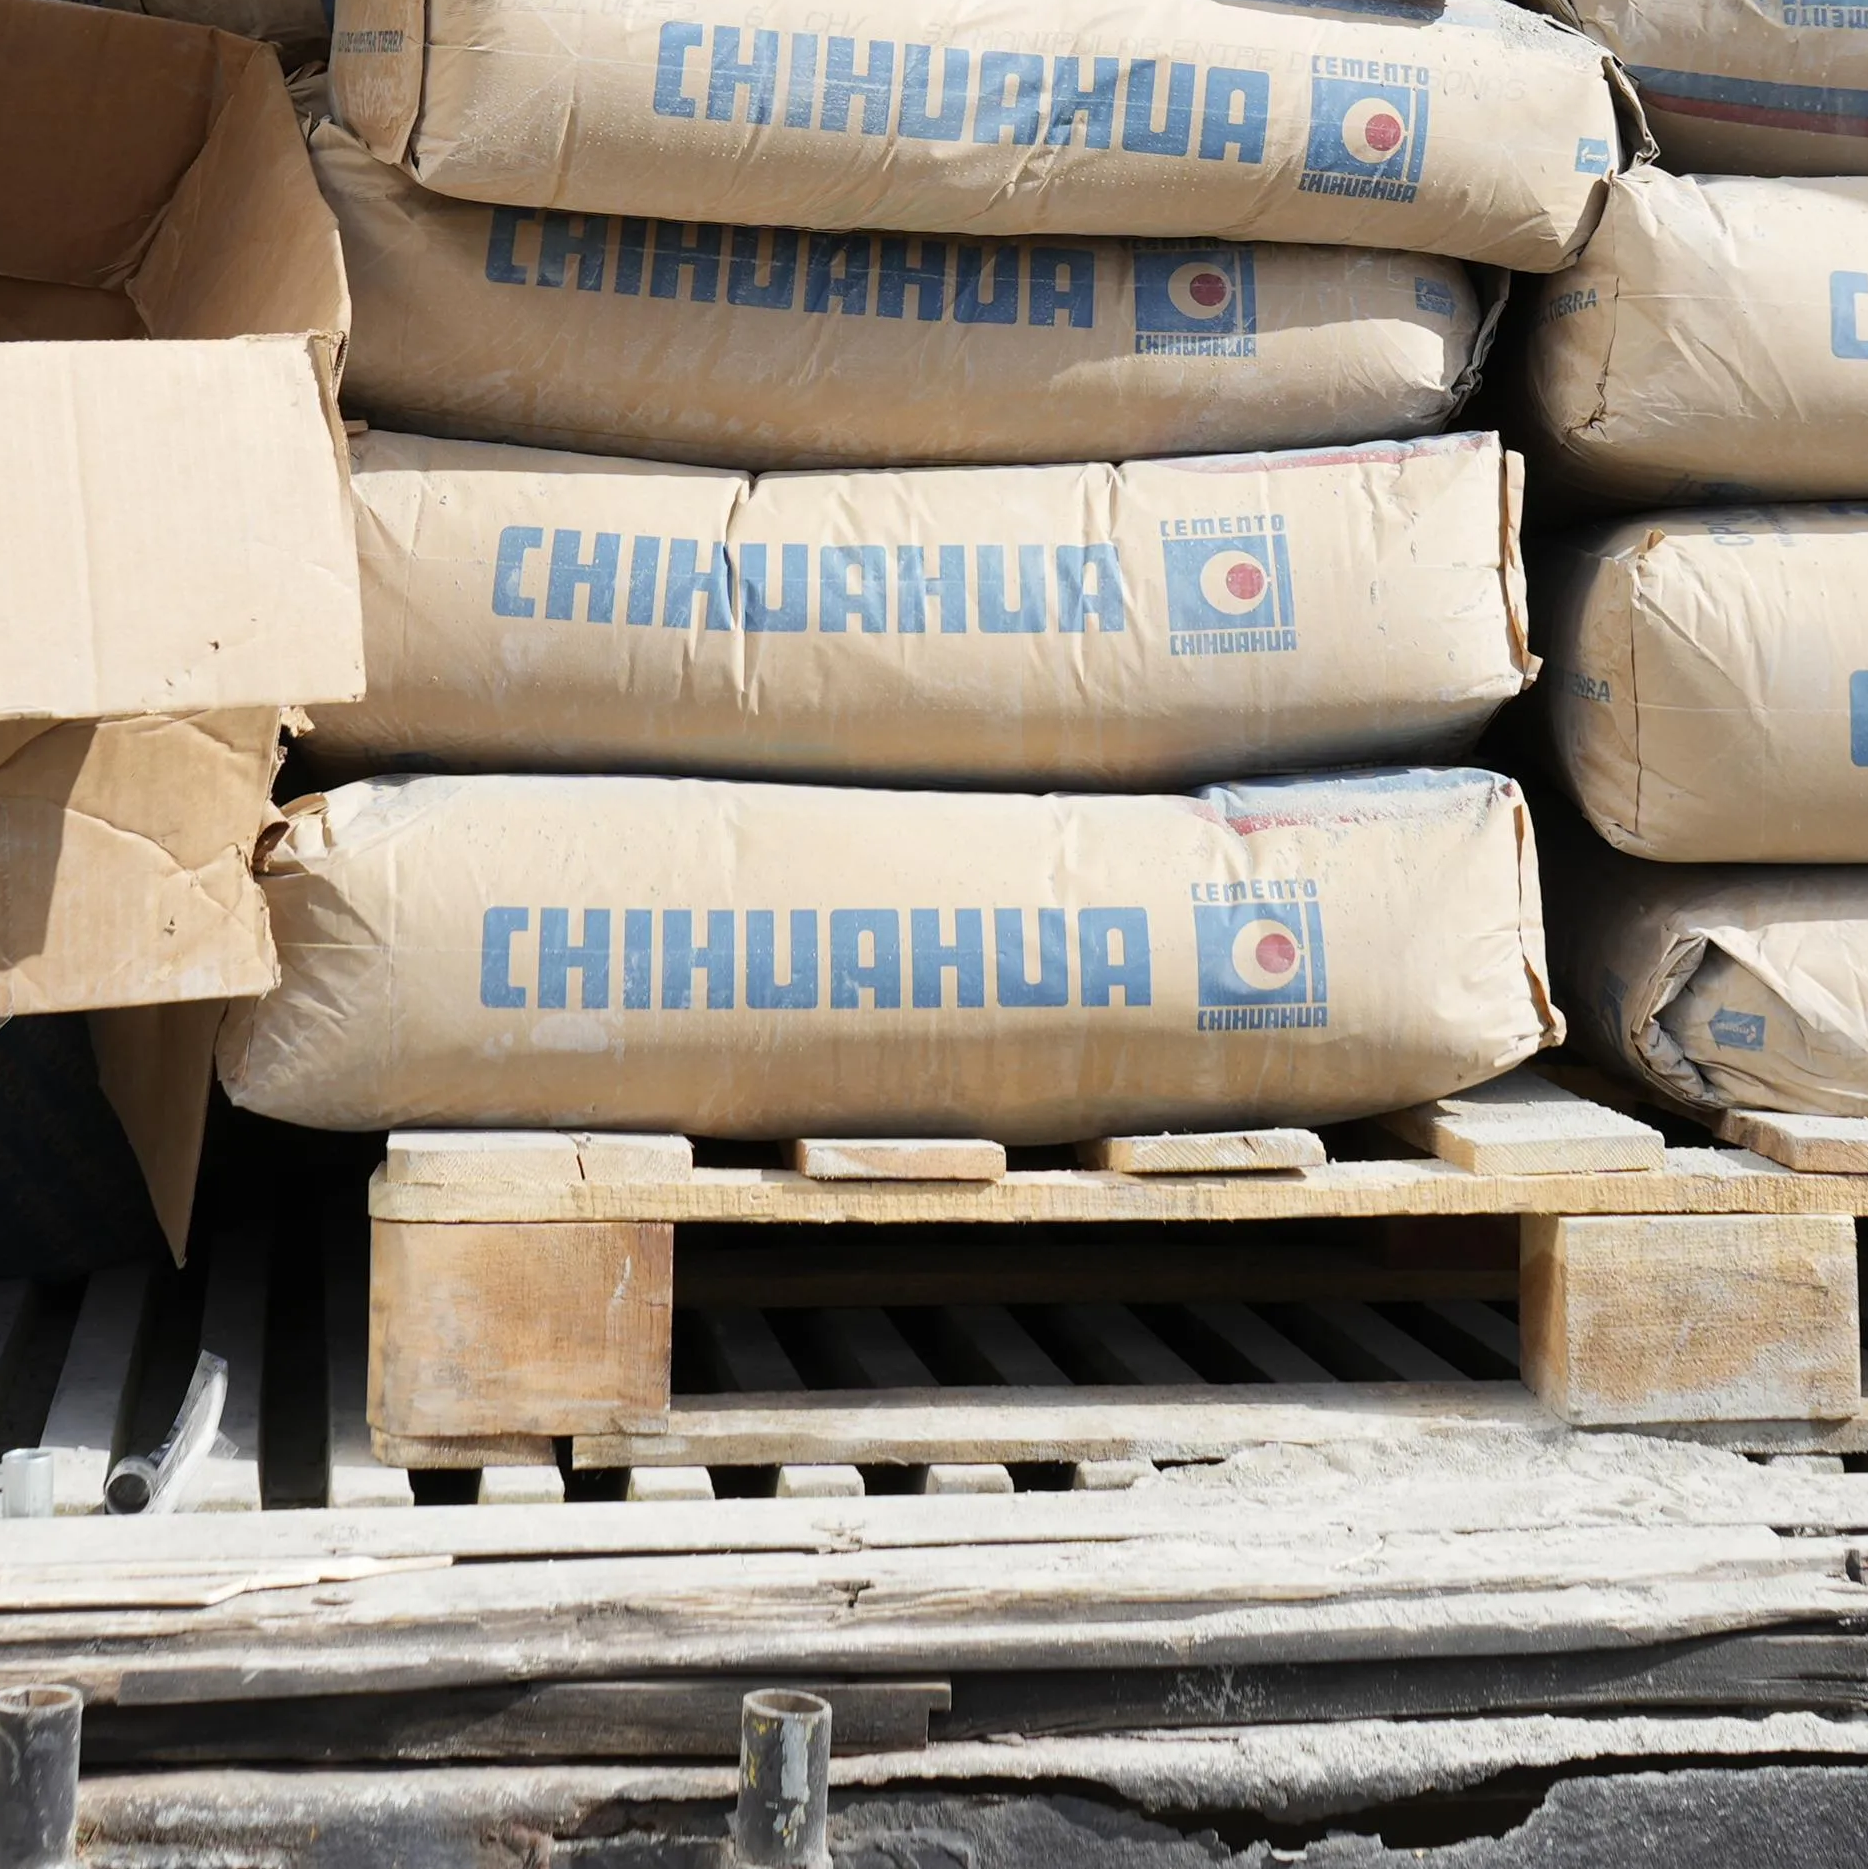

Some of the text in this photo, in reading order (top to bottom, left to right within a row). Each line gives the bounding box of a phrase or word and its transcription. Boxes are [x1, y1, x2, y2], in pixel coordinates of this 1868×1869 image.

[1311, 53, 1430, 87] CEMENTO
[652, 20, 1270, 165] CHIHUAHUA
[1298, 171, 1417, 204] CHIHUAHUA
[484, 207, 1096, 329] CHIHUAHUA
[1134, 333, 1257, 358] CHIHUAHUA
[1159, 513, 1286, 538] CEMENTO
[491, 525, 1126, 633] CHIHUAHUA
[1169, 628, 1297, 657] CHIHUAHUA
[1190, 878, 1319, 902] CEMENTO
[480, 905, 1152, 1010] CHIHUAHUA
[1196, 1005, 1328, 1031] CHIHUAHUA
